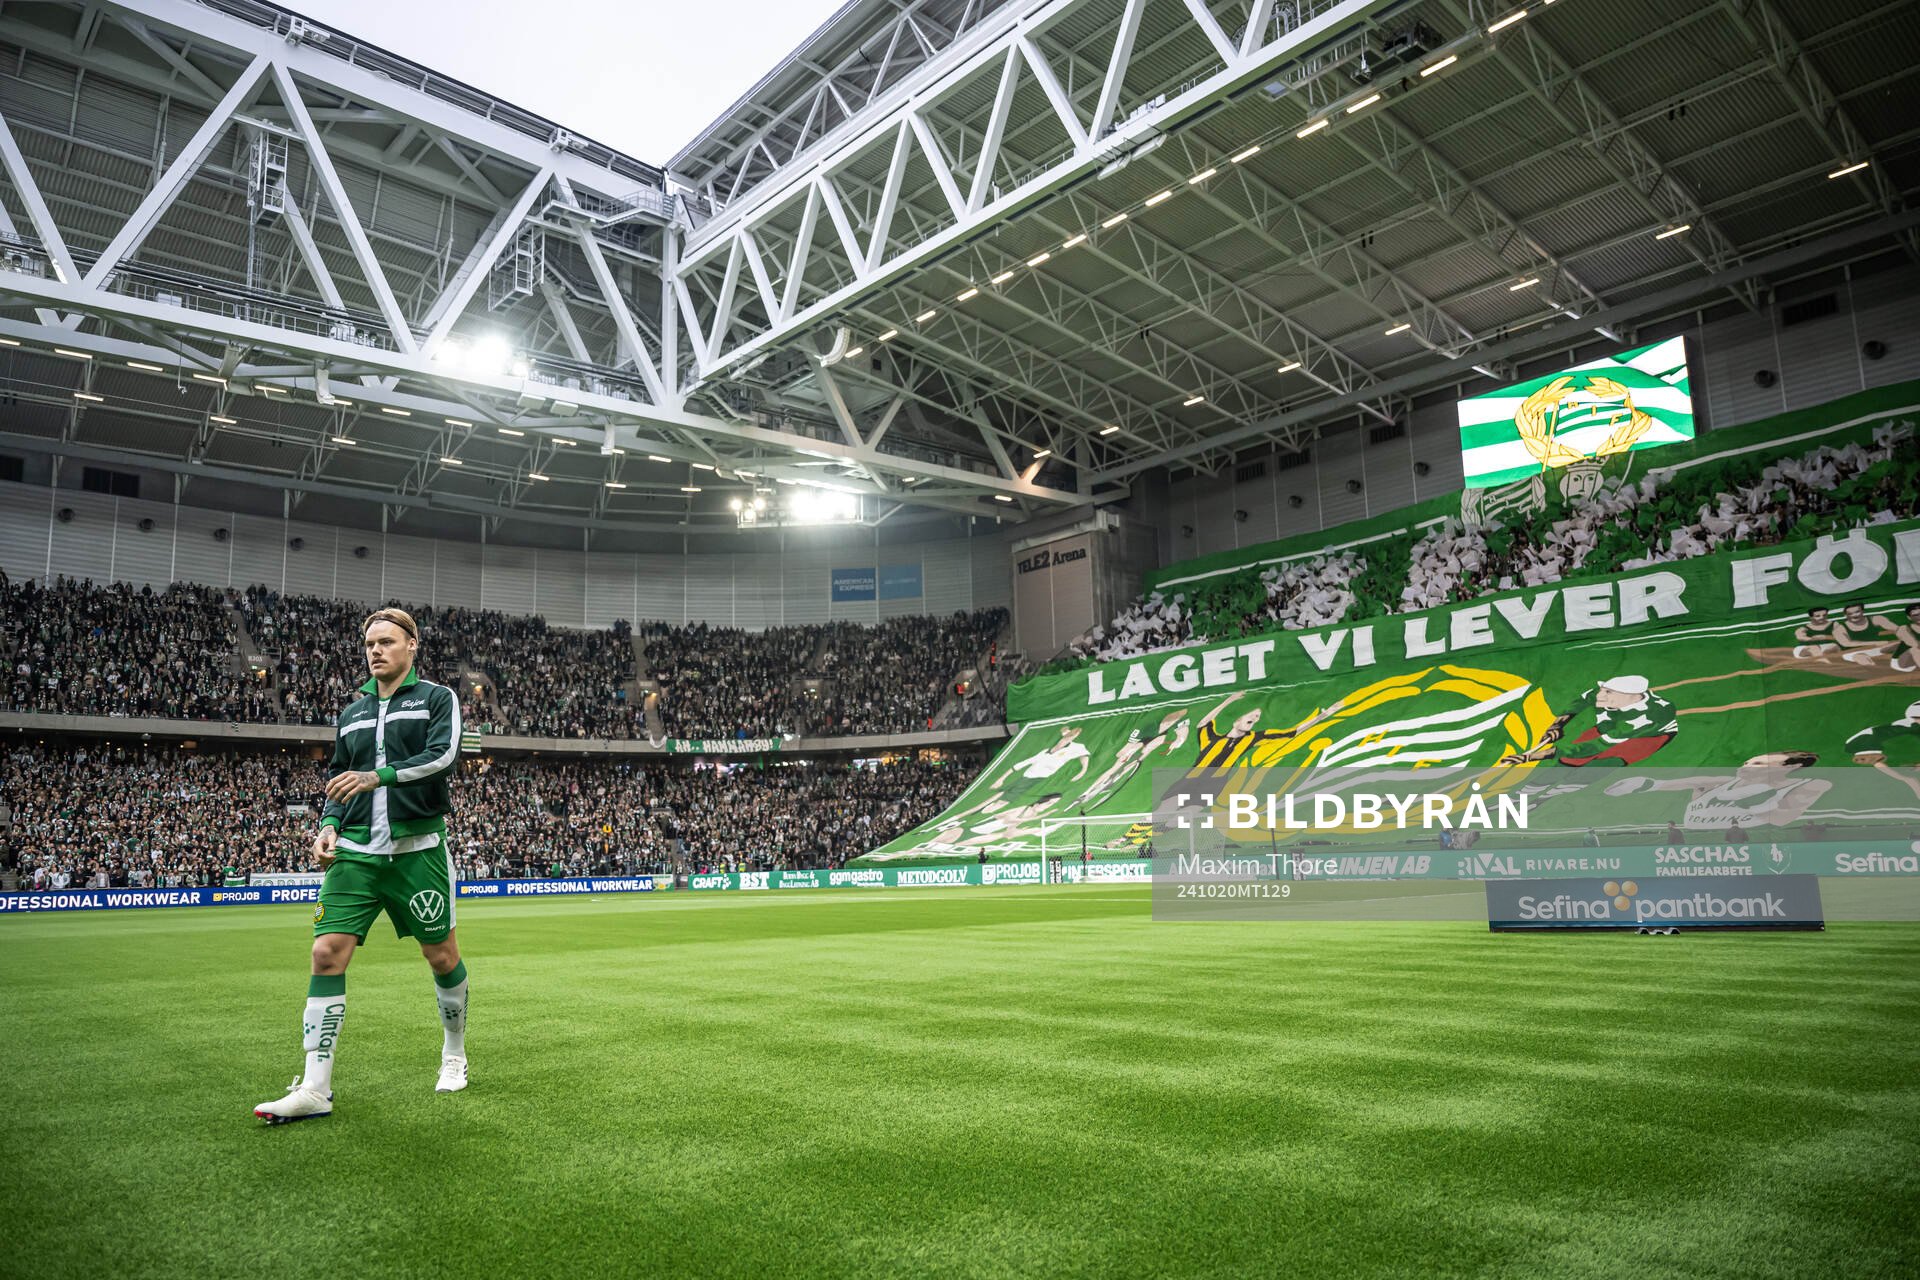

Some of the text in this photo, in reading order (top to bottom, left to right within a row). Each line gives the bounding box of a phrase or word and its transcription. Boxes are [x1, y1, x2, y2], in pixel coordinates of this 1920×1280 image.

[1017, 548, 1087, 575] TELE2 Arena
[1088, 640, 1275, 705] LAGET
[1298, 625, 1377, 671] VI
[1404, 571, 1690, 659] LEVER
[1655, 845, 1750, 863] SASCHAS
[1400, 855, 1431, 874] AB
[1457, 853, 1621, 876] RIVAL RIVARE.NU
[1656, 865, 1753, 876] FAMILJEARBETE
[1835, 852, 1919, 873] Sefina
[829, 869, 883, 885] ggmgastro
[896, 868, 968, 884] METODGOLV
[996, 863, 1041, 879] PROJOB
[507, 879, 652, 894] PROFESSIONAL WORKWEAR
[692, 876, 723, 889] CRAFT
[739, 871, 770, 888] BST
[222, 891, 260, 902] PROJOB
[271, 889, 321, 901] PROFE
[468, 885, 499, 894] PROJOB
[107, 892, 200, 907] WORKWEAR
[1518, 893, 1786, 923] Sefina pantbank
